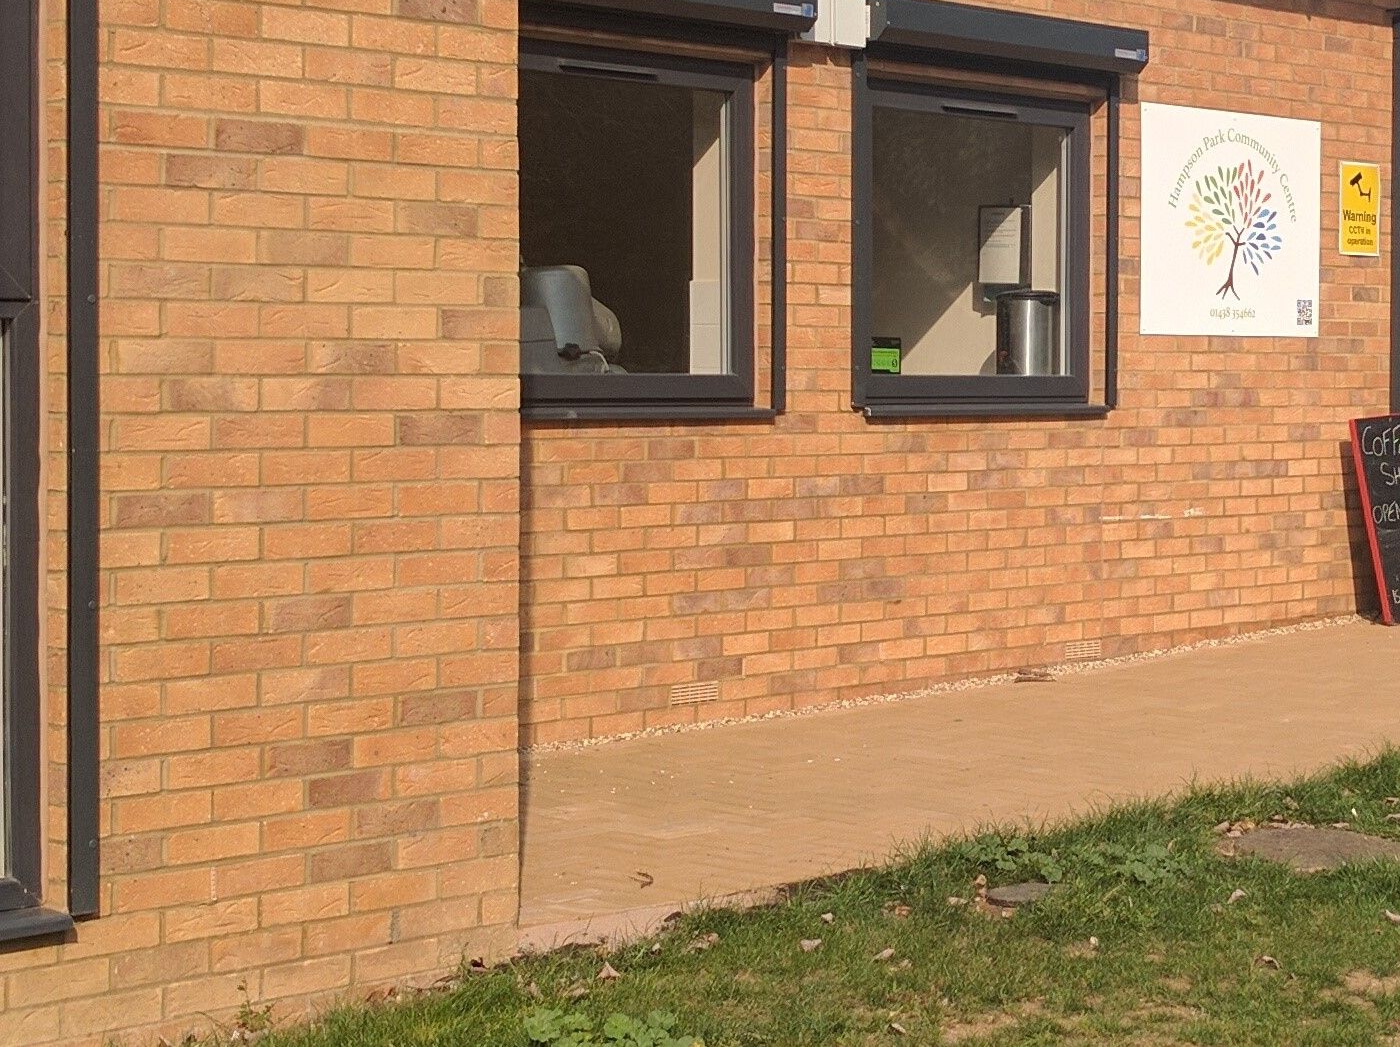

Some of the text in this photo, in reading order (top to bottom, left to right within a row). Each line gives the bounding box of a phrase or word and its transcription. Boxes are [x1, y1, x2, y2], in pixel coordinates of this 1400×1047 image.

[1168, 128, 1297, 223] Hampson Park Community Centre
[1343, 209, 1377, 226] Warning
[1349, 226, 1364, 235] CCTV
[1347, 237, 1374, 246] operation
[1210, 306, 1230, 319] 01438
